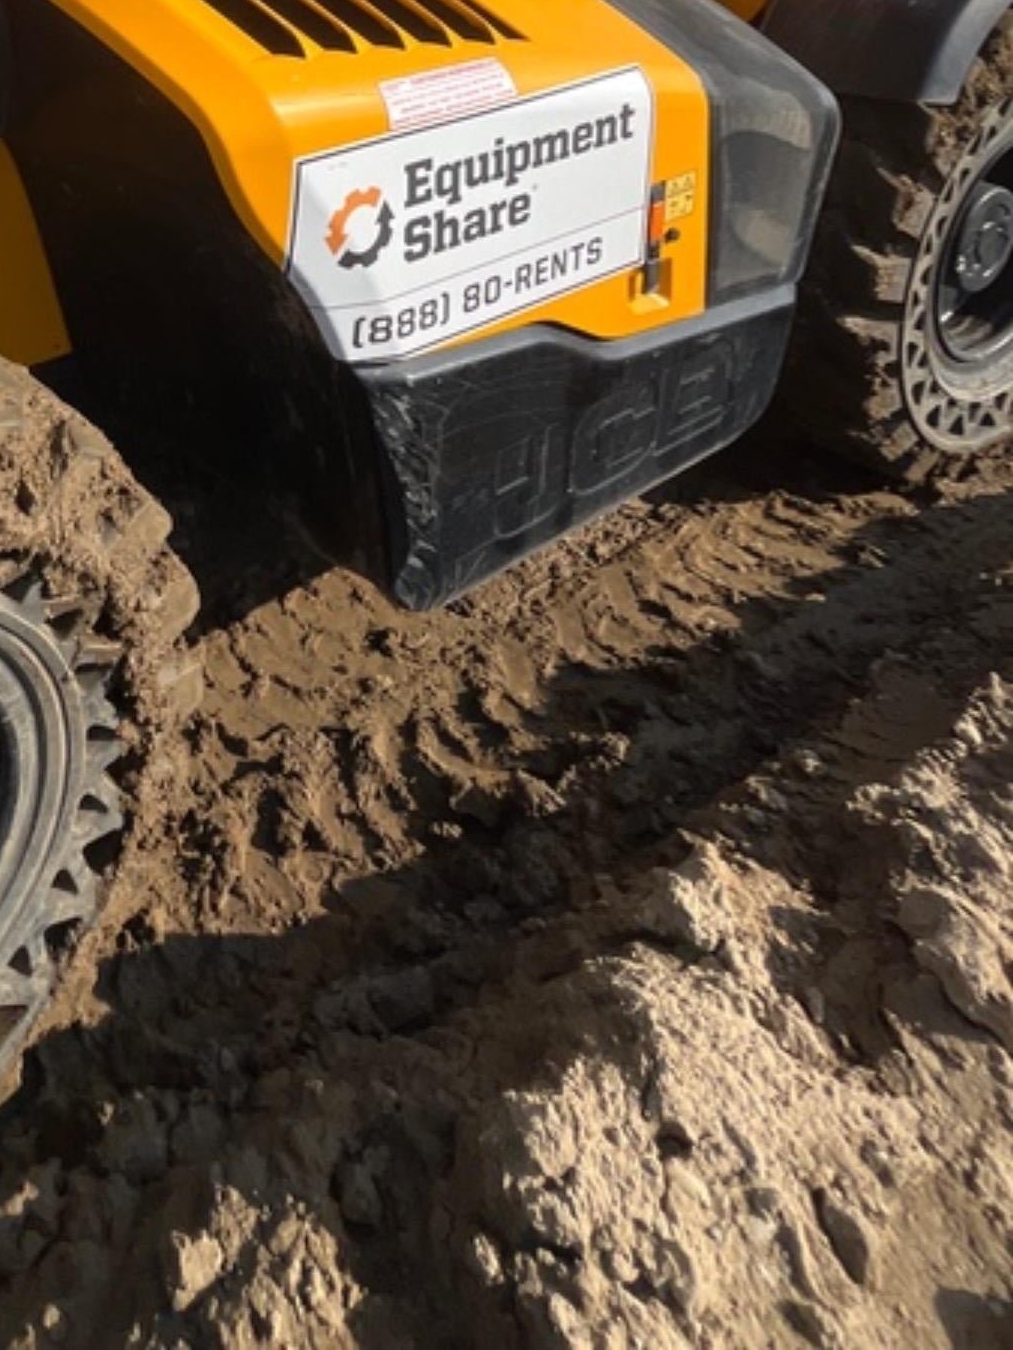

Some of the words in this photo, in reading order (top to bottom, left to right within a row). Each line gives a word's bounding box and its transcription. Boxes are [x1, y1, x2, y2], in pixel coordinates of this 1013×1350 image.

[403, 102, 636, 207] Equipment
[402, 191, 532, 263] Share
[352, 295, 451, 349] (888)
[462, 236, 605, 314] 80-RENTS
